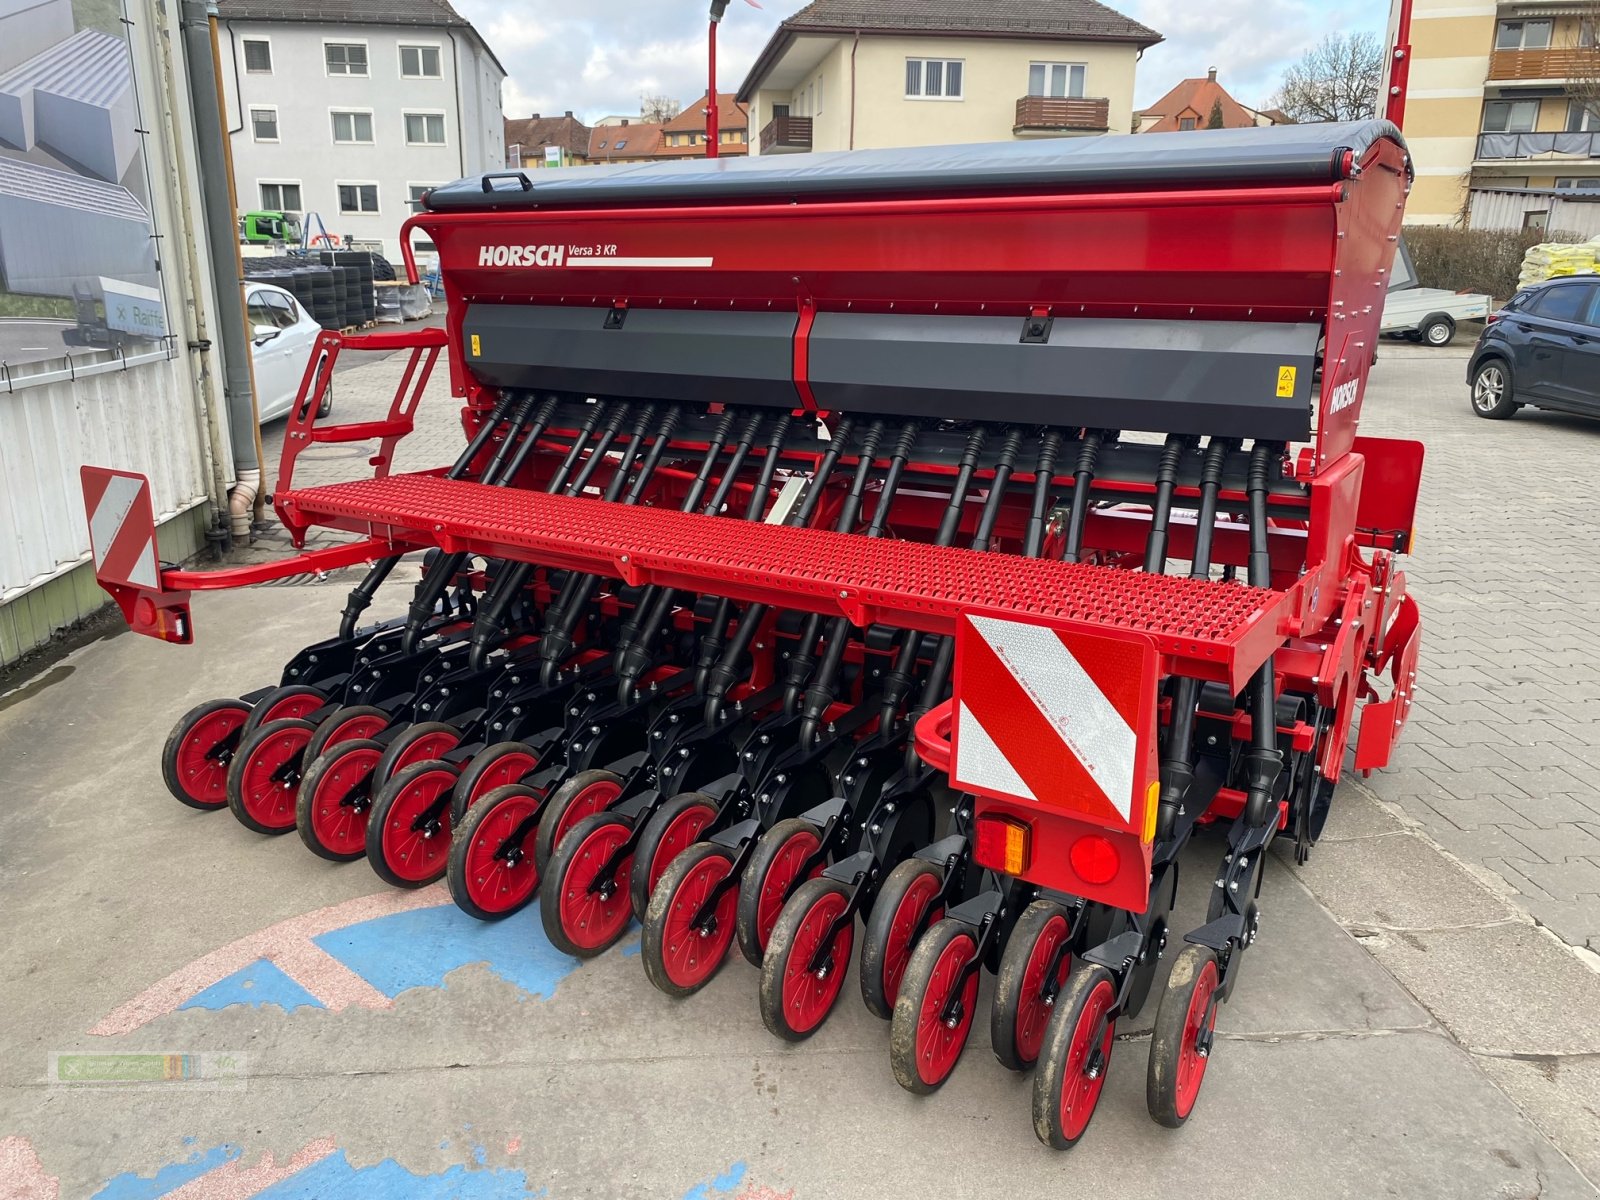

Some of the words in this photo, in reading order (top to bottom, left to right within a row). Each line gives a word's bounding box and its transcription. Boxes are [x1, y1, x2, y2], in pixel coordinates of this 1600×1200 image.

[478, 245, 564, 267] HORSCH
[568, 245, 593, 256] Versa
[595, 245, 602, 256] 3
[603, 245, 617, 256] KR
[1330, 378, 1359, 415] HORSCH
